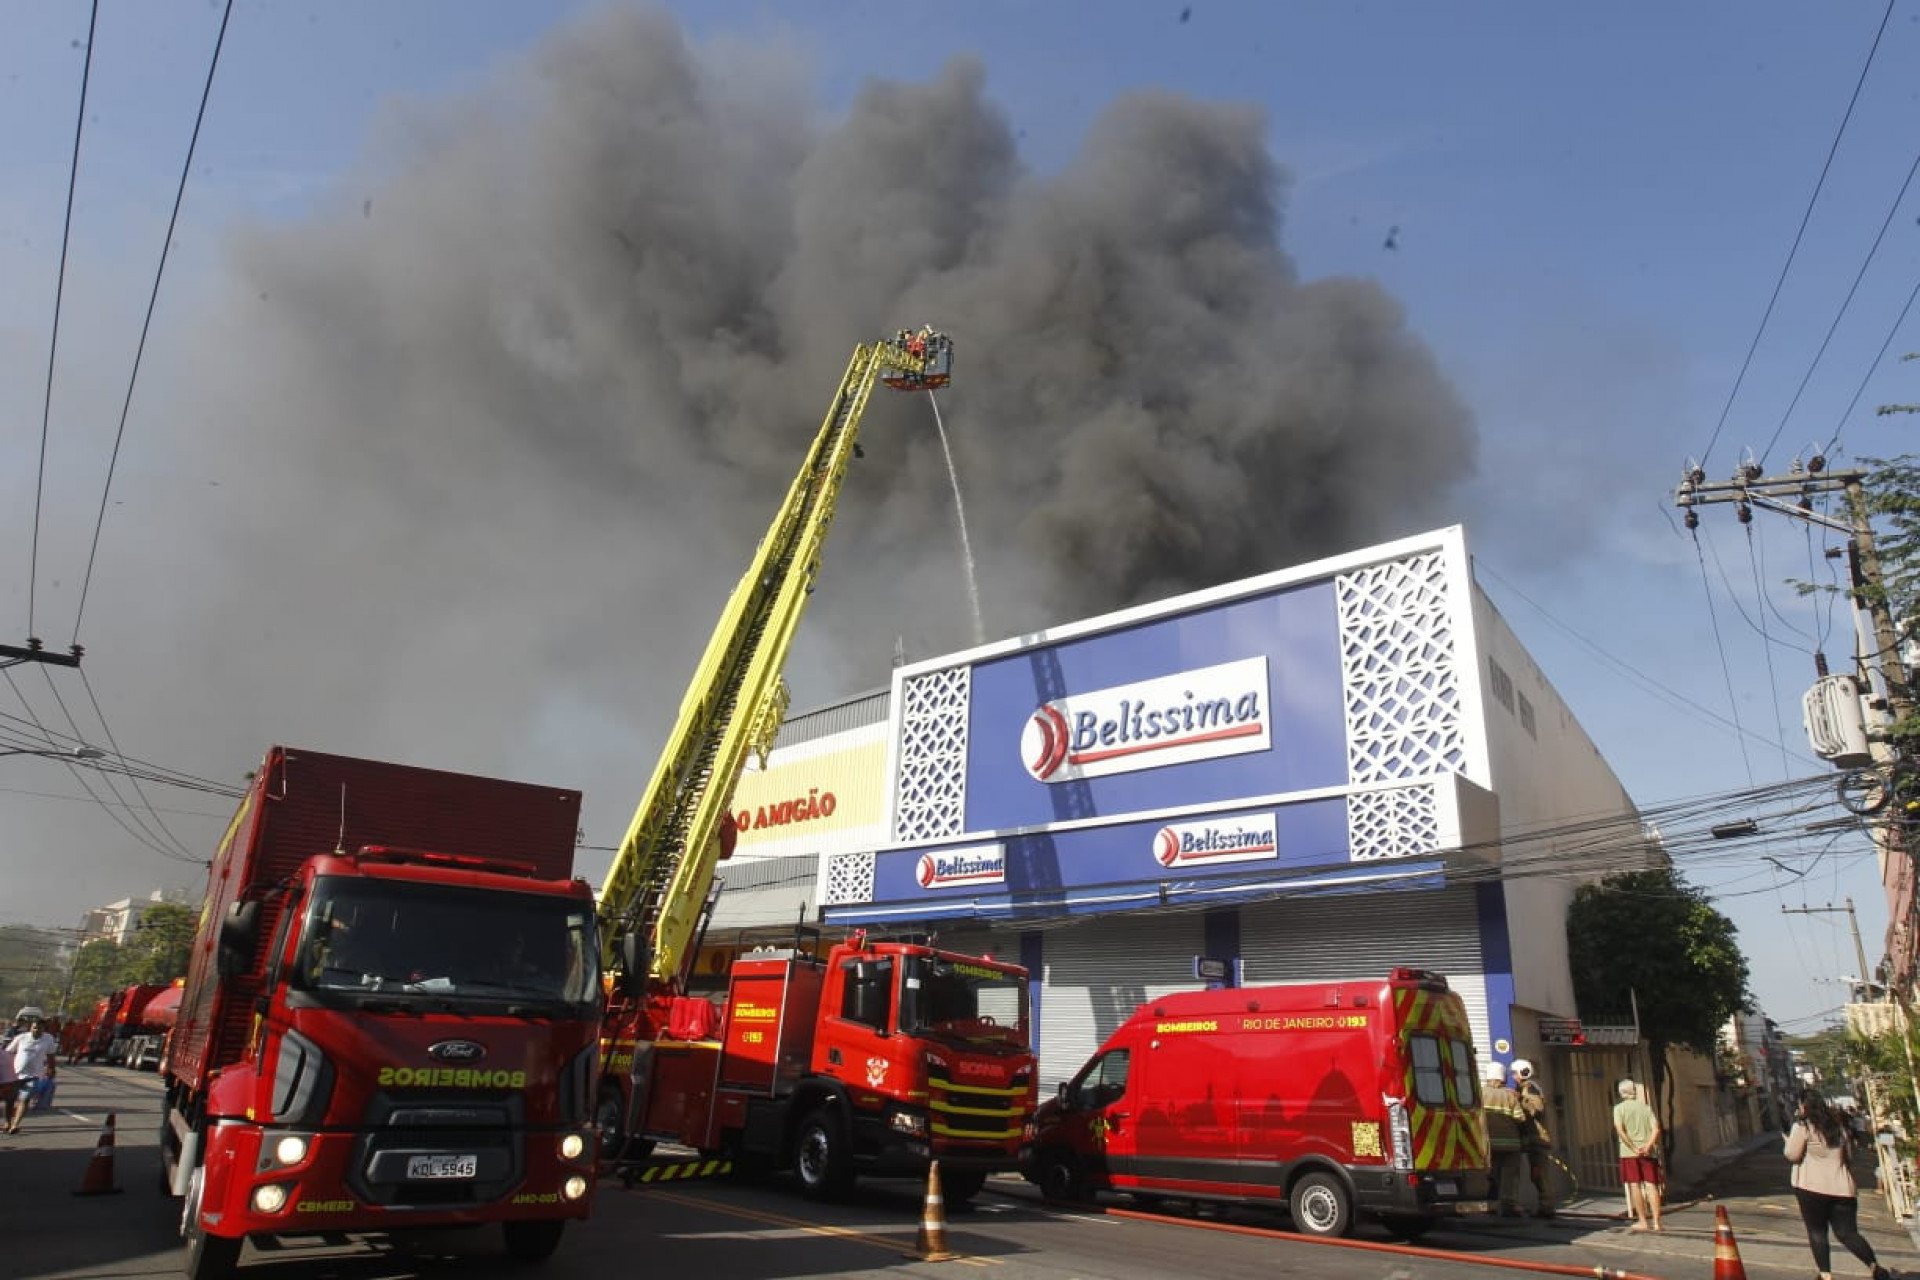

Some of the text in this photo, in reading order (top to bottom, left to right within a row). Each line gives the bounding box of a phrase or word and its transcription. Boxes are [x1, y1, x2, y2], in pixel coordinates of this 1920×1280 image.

[1071, 691, 1259, 751] Belíssima
[753, 787, 837, 830] AMIGÃO
[1157, 1021, 1218, 1032] BOMBEIROS
[1243, 1018, 1262, 1030] RIO
[1265, 1018, 1281, 1030] DE
[1283, 1017, 1334, 1029] JANEIRO
[442, 1043, 474, 1058] Ford
[441, 1163, 473, 1175] 5945
